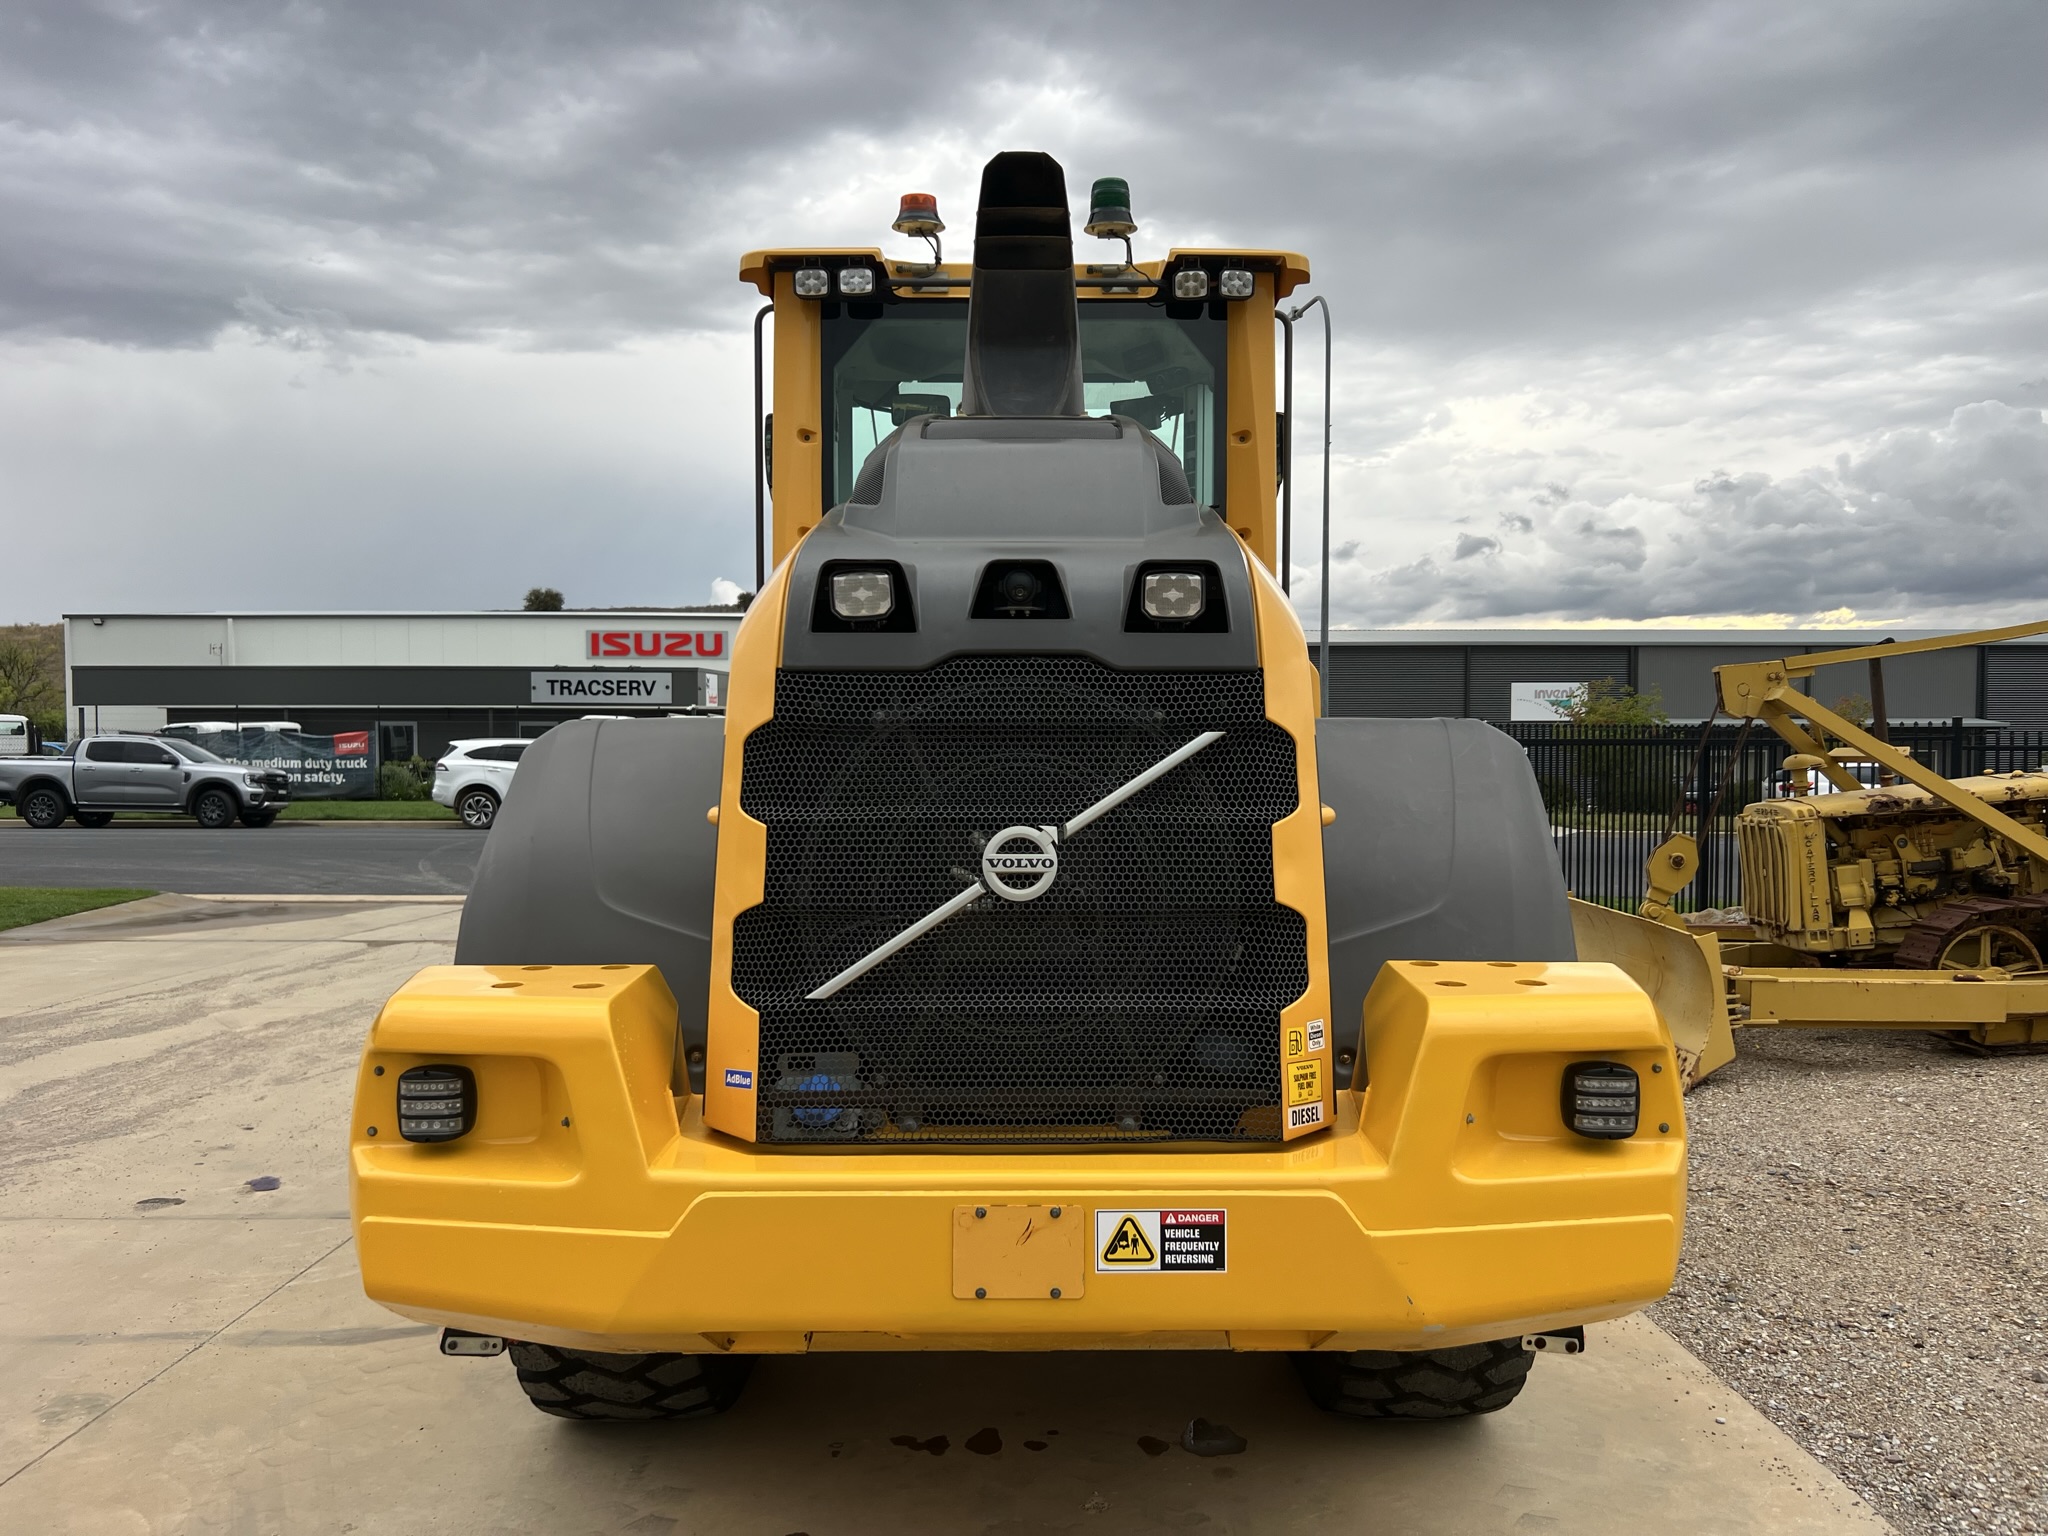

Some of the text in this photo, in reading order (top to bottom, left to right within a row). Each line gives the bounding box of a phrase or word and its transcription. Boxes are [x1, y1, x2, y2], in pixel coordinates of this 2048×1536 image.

[591, 632, 723, 657] ISUZU
[546, 679, 657, 696] TRACSERV
[252, 757, 302, 768] medium
[304, 758, 333, 771] duty
[335, 757, 367, 768] truck
[304, 771, 346, 785] safety.
[986, 858, 1054, 868] VOLVO
[1804, 840, 1820, 922] CATERPILLAR
[726, 1073, 751, 1085] AdBlue
[1293, 1071, 1317, 1082] SULPHUR FREE
[1298, 1081, 1314, 1090] FUEL ONLY
[1292, 1106, 1320, 1127] DIESEL
[1178, 1214, 1219, 1222] DANGER
[1165, 1229, 1200, 1238] VEHICLE
[1165, 1241, 1219, 1251] FREQUENTLY
[1165, 1254, 1214, 1264] REVERSING
